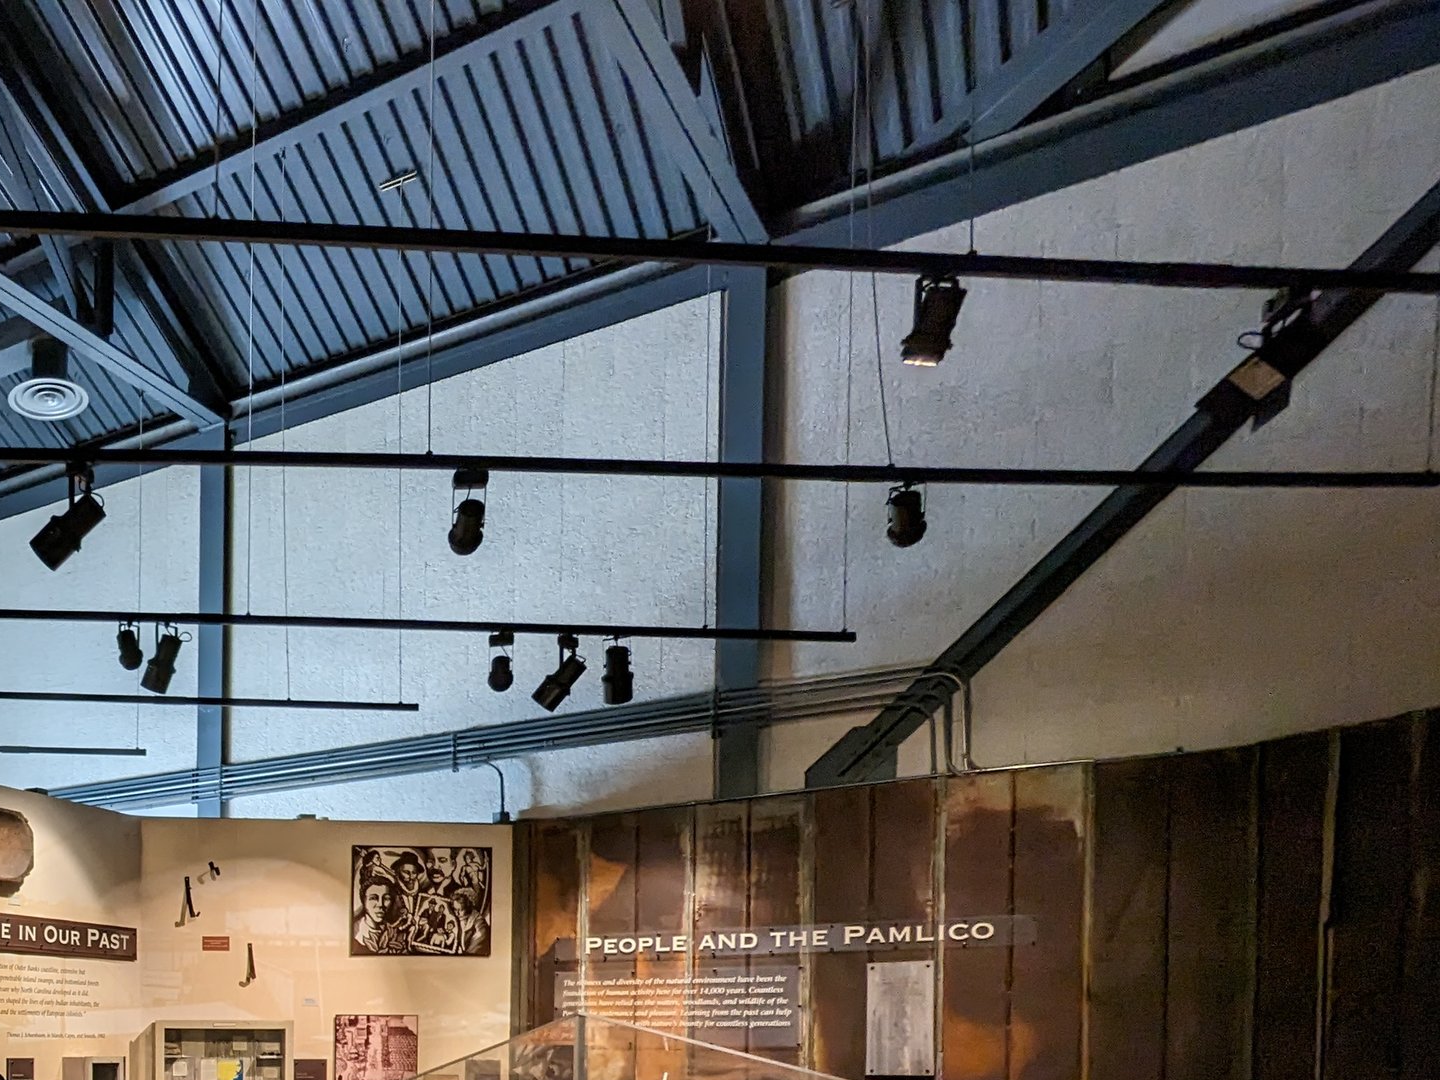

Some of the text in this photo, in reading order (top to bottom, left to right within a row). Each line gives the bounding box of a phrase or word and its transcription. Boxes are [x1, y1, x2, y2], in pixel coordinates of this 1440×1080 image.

[19, 925, 36, 941] IN
[44, 925, 81, 946] OUR
[87, 929, 129, 950] PAST
[585, 922, 994, 954] PEOPLE AND THE PAMLICO
